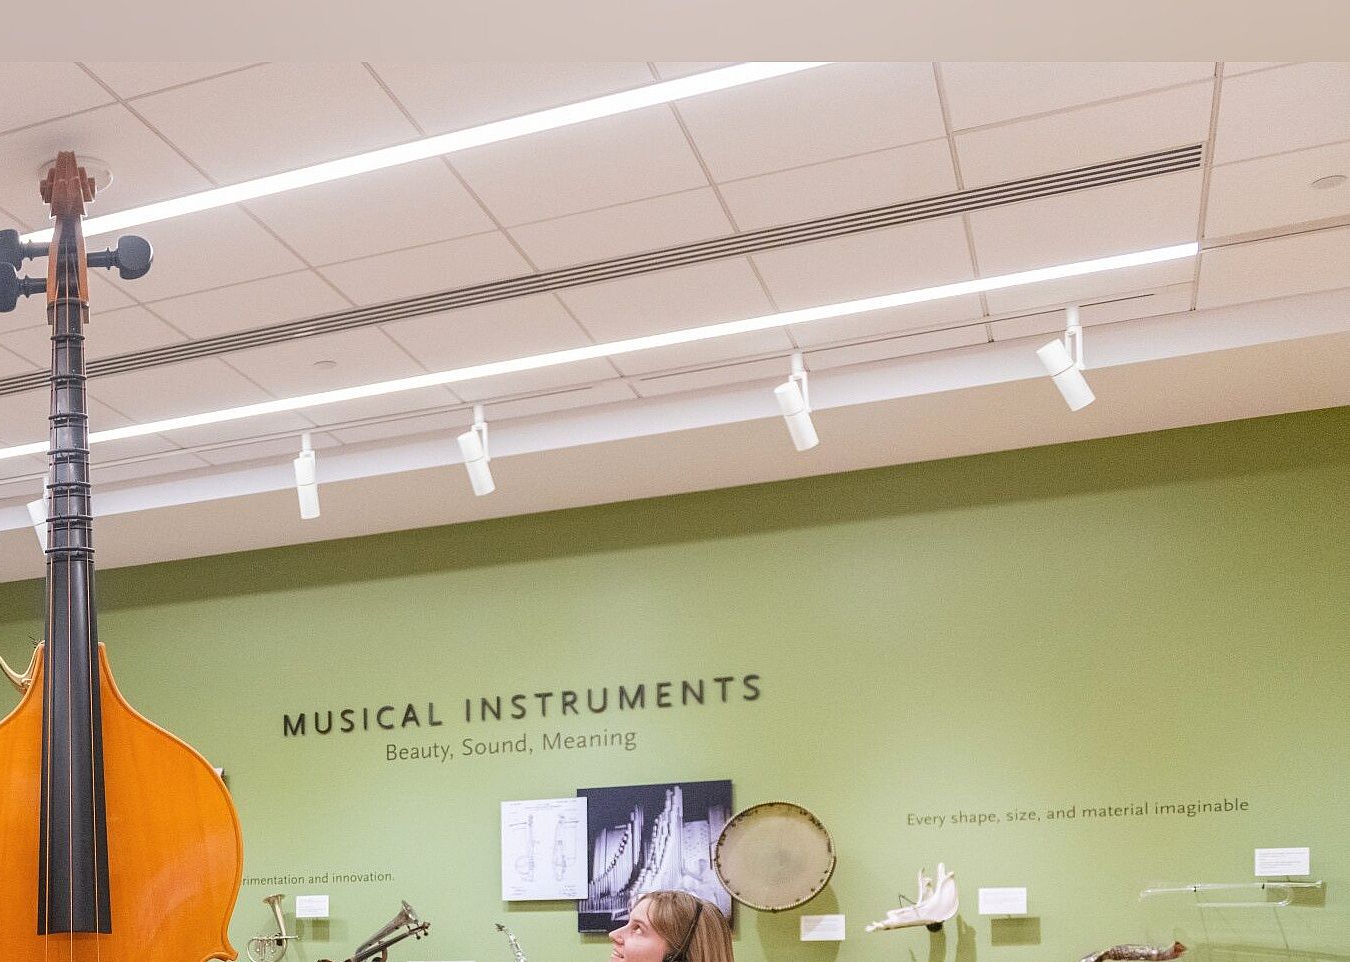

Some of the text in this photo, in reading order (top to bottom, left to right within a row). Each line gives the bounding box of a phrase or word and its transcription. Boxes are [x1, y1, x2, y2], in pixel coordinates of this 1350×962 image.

[282, 674, 762, 737] MUSICAL INSTRUMENTS
[385, 730, 637, 763] Beauty, Sound, Meaning
[907, 797, 1249, 829] Every shape, size, and material imaginable
[308, 873, 329, 884] and
[332, 871, 395, 883] innovation.
